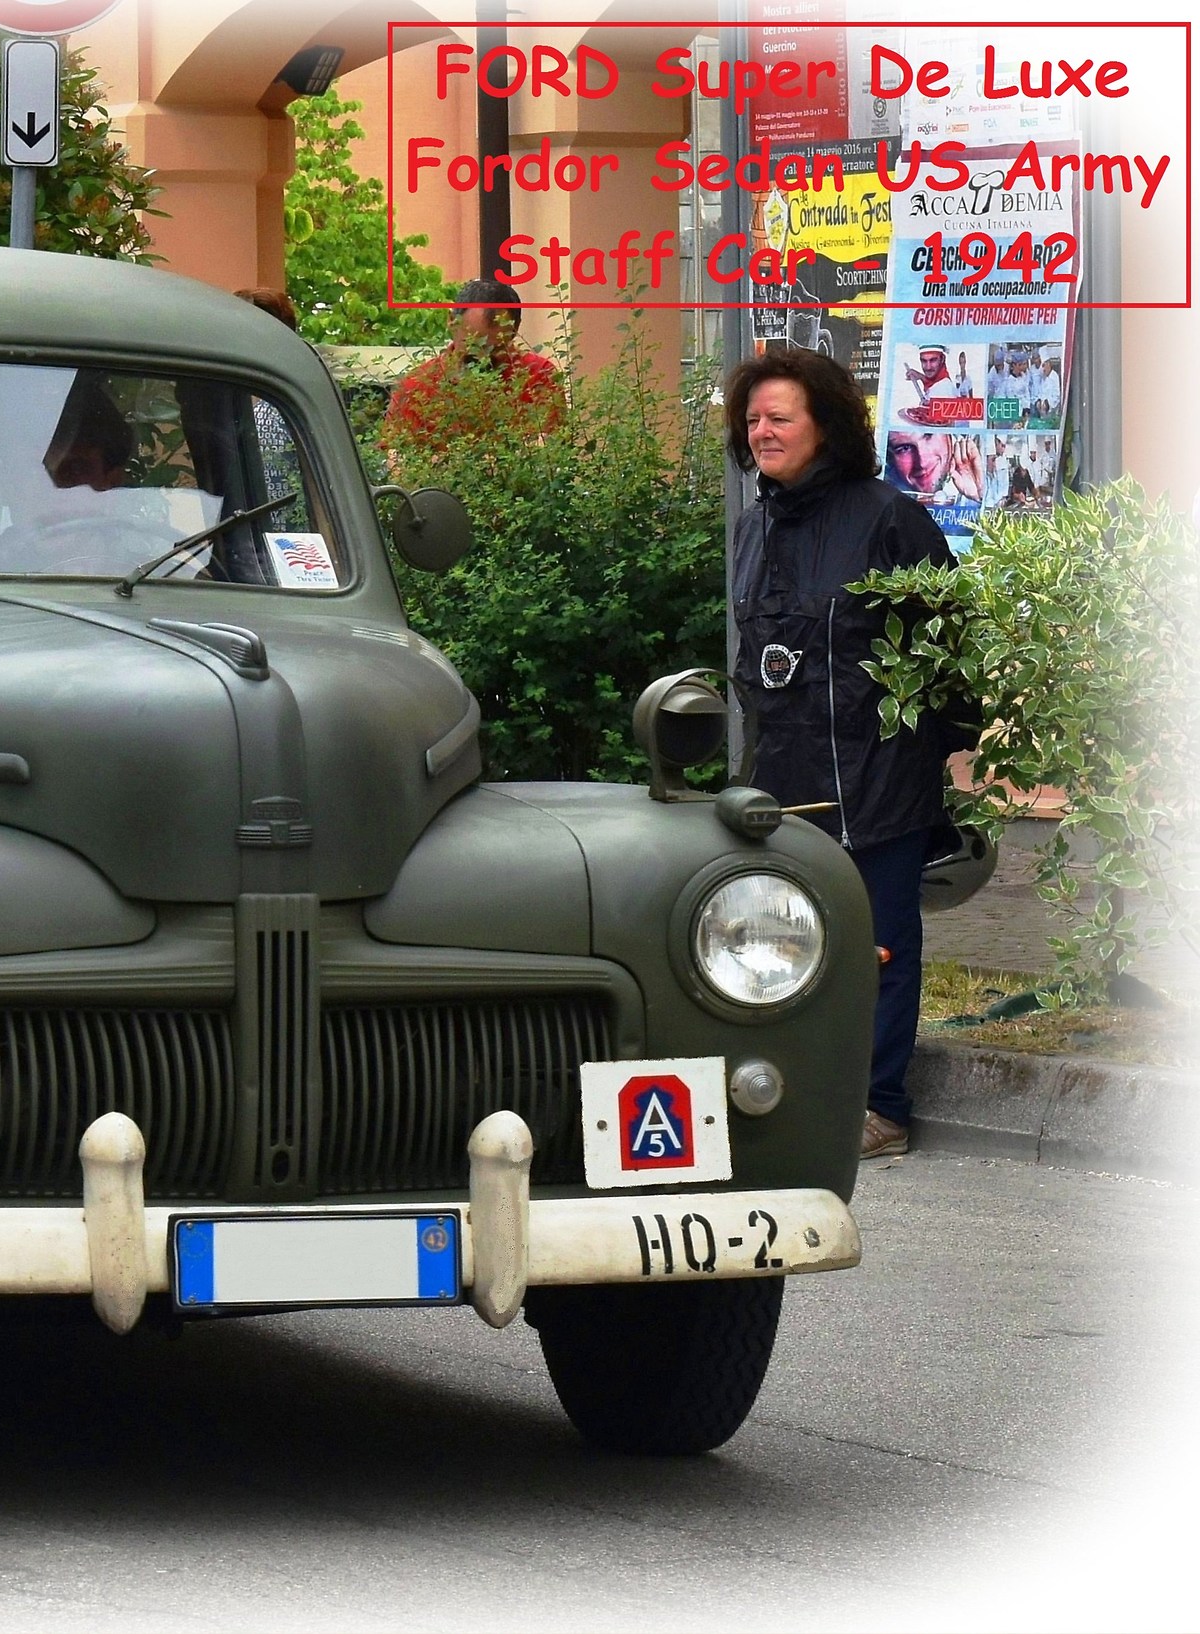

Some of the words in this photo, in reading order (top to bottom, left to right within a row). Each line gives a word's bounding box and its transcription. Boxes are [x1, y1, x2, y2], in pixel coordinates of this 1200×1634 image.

[763, 40, 797, 54] Guercino
[807, 147, 814, 157] 14
[843, 143, 861, 155] 2016
[788, 195, 848, 235] Contrada
[851, 206, 859, 223] in
[944, 219, 982, 230] CUCINA
[988, 218, 1033, 229] ITALIANA
[922, 280, 946, 297] Una
[950, 283, 978, 296] nuova
[982, 281, 1053, 299] occupazione?
[913, 308, 952, 325] CORSI
[955, 308, 965, 325] DI
[967, 308, 1034, 325] FORMAZIONE
[1036, 307, 1058, 325] PER
[931, 402, 983, 419] PIZZAIOLO
[988, 401, 1017, 419] CHEF
[930, 509, 978, 525] BARMAN
[632, 1092, 682, 1152] A
[648, 1133, 665, 1158] 5
[632, 1209, 783, 1275] HQ-2
